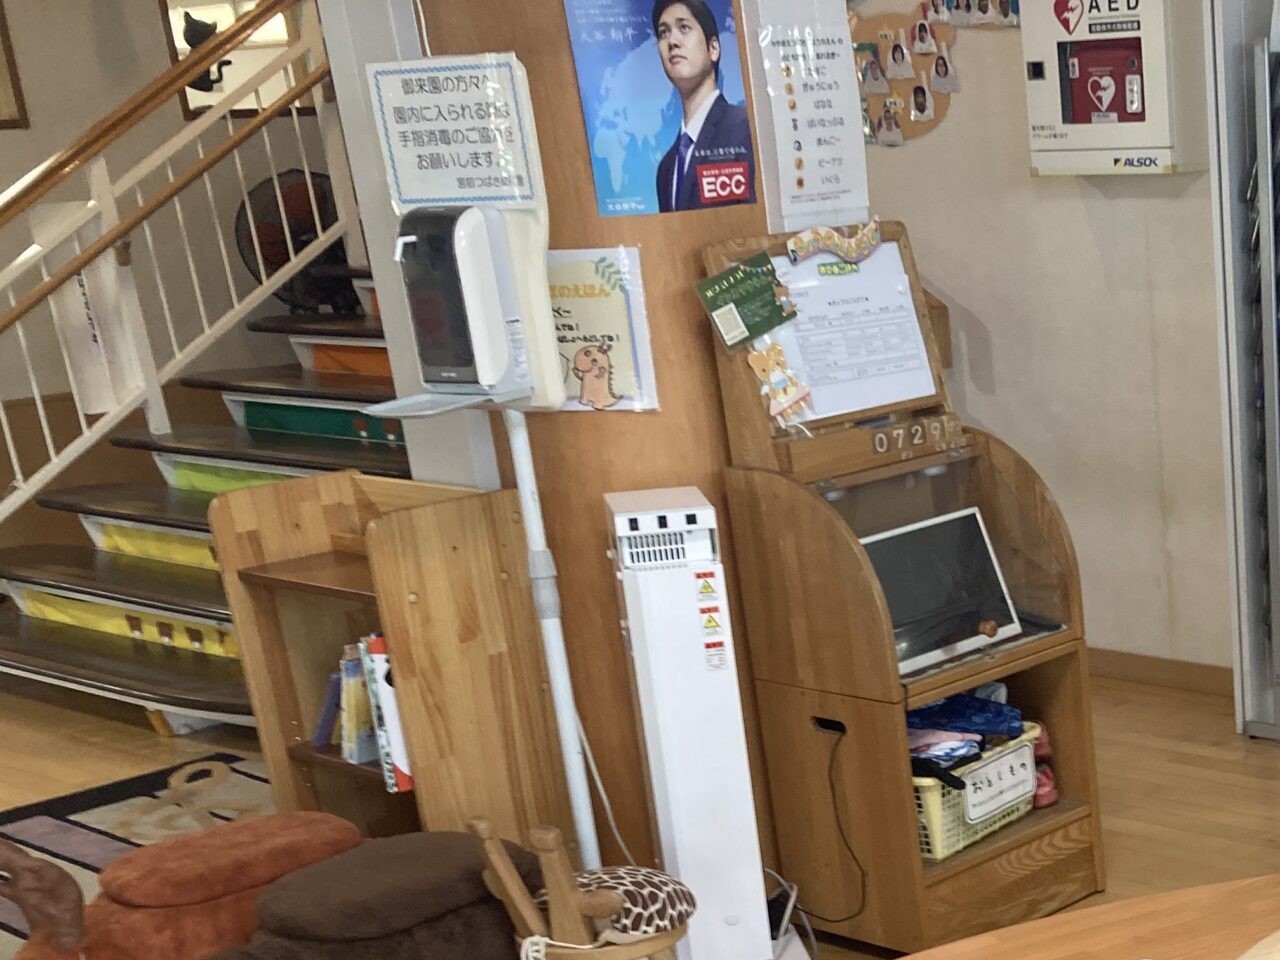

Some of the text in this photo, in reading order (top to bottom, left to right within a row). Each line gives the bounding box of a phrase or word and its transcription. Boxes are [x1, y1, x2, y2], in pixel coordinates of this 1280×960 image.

[1088, 0, 1139, 13] AED
[1123, 156, 1158, 168] ALSOK
[702, 175, 746, 198] ECC
